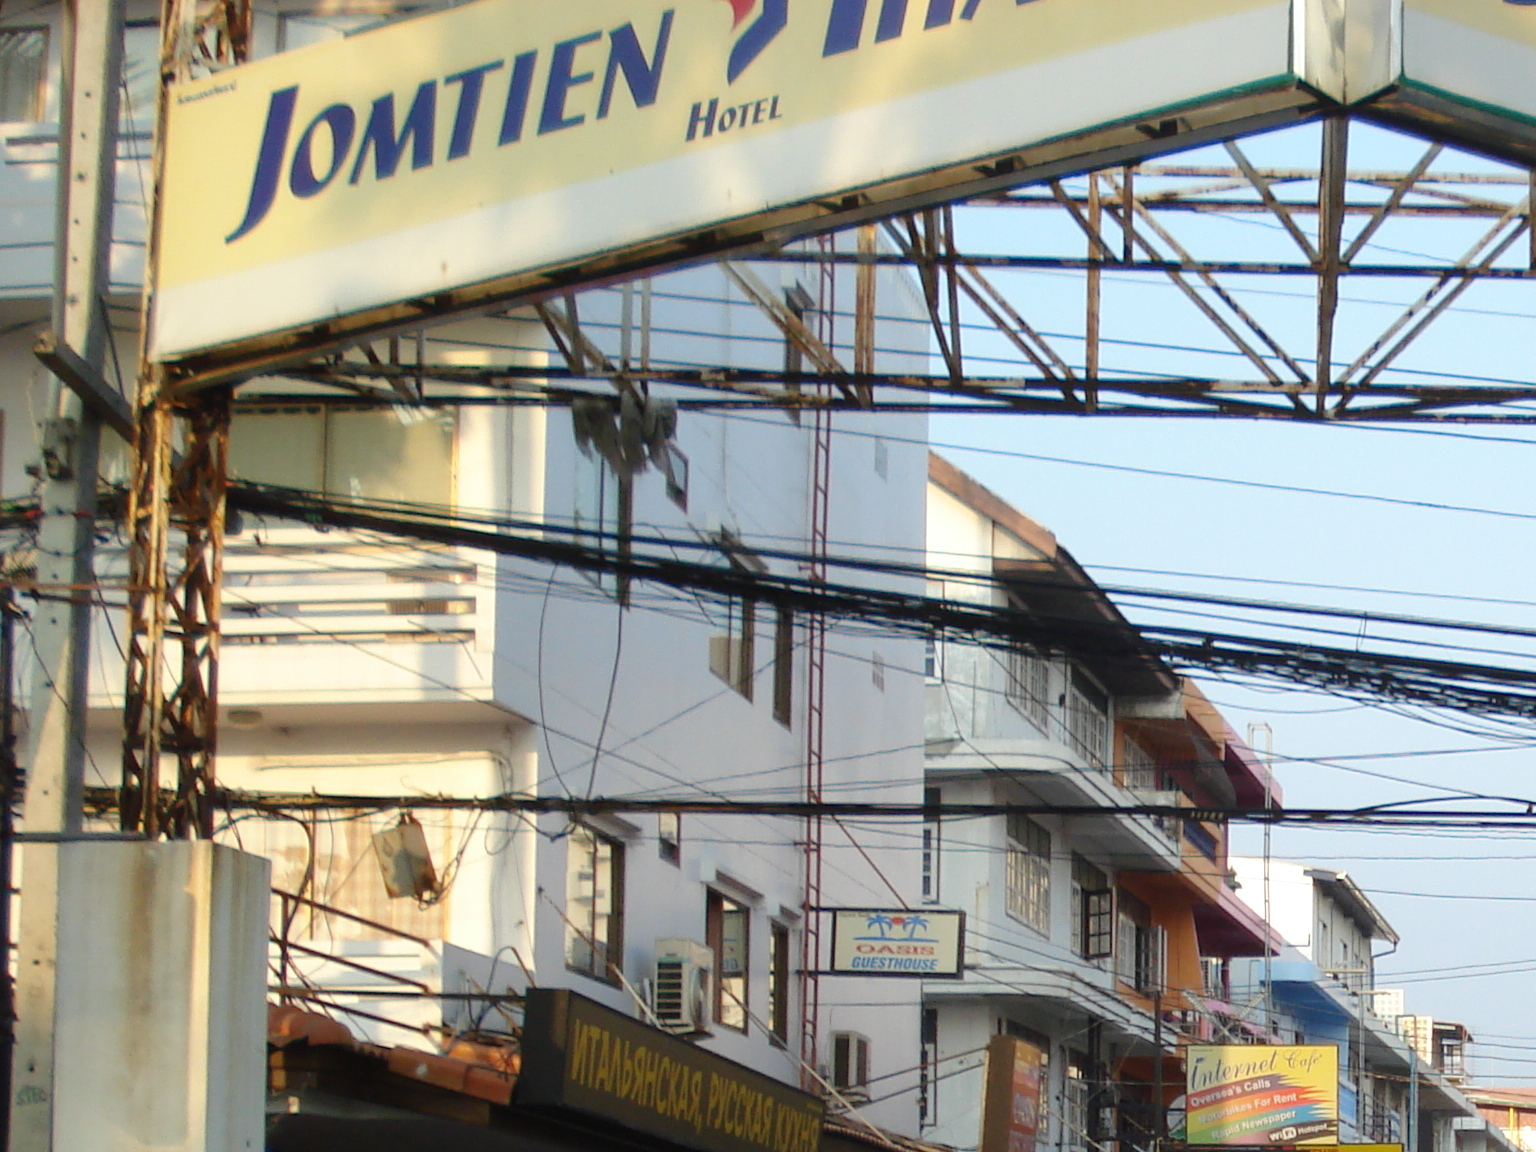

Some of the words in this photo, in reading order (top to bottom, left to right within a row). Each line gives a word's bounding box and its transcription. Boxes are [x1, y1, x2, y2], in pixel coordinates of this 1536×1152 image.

[224, 8, 674, 244] JOMTIEN
[685, 94, 783, 142] HOTEL
[851, 956, 939, 971] GUESTHOUSE
[856, 944, 935, 956] OASIS
[571, 1018, 703, 1136] ИТАЛЬЯНСКАЯ,
[706, 1072, 775, 1148] РУССКАЯ
[1191, 1050, 1278, 1092] Internet
[1190, 1083, 1243, 1107] Oversea's
[1244, 1079, 1271, 1092] Calls
[1198, 1102, 1253, 1125] Motorbikes
[1254, 1097, 1271, 1108] For
[1273, 1092, 1298, 1104] Rent
[1242, 1109, 1297, 1130] Newspaper
